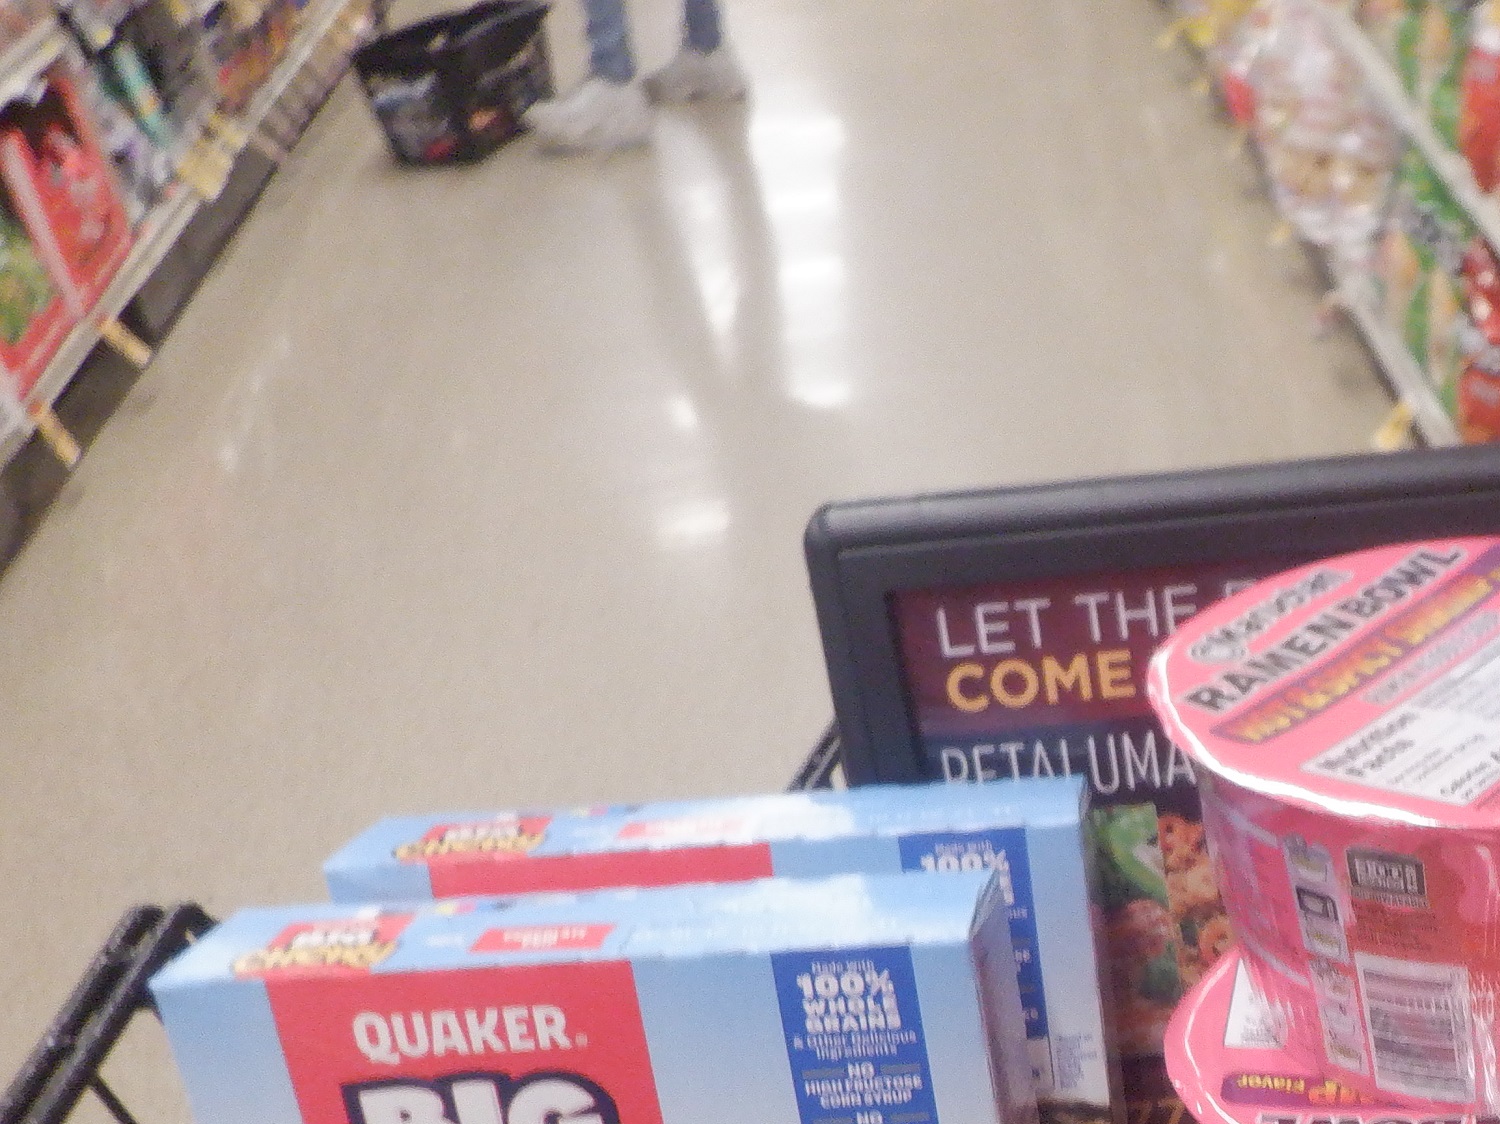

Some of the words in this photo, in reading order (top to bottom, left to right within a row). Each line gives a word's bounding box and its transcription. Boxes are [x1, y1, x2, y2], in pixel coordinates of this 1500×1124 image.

[936, 597, 1052, 660] LET
[945, 649, 1138, 713] COME
[1184, 611, 1356, 714] RAMEN
[352, 1003, 574, 1065] QUAKER
